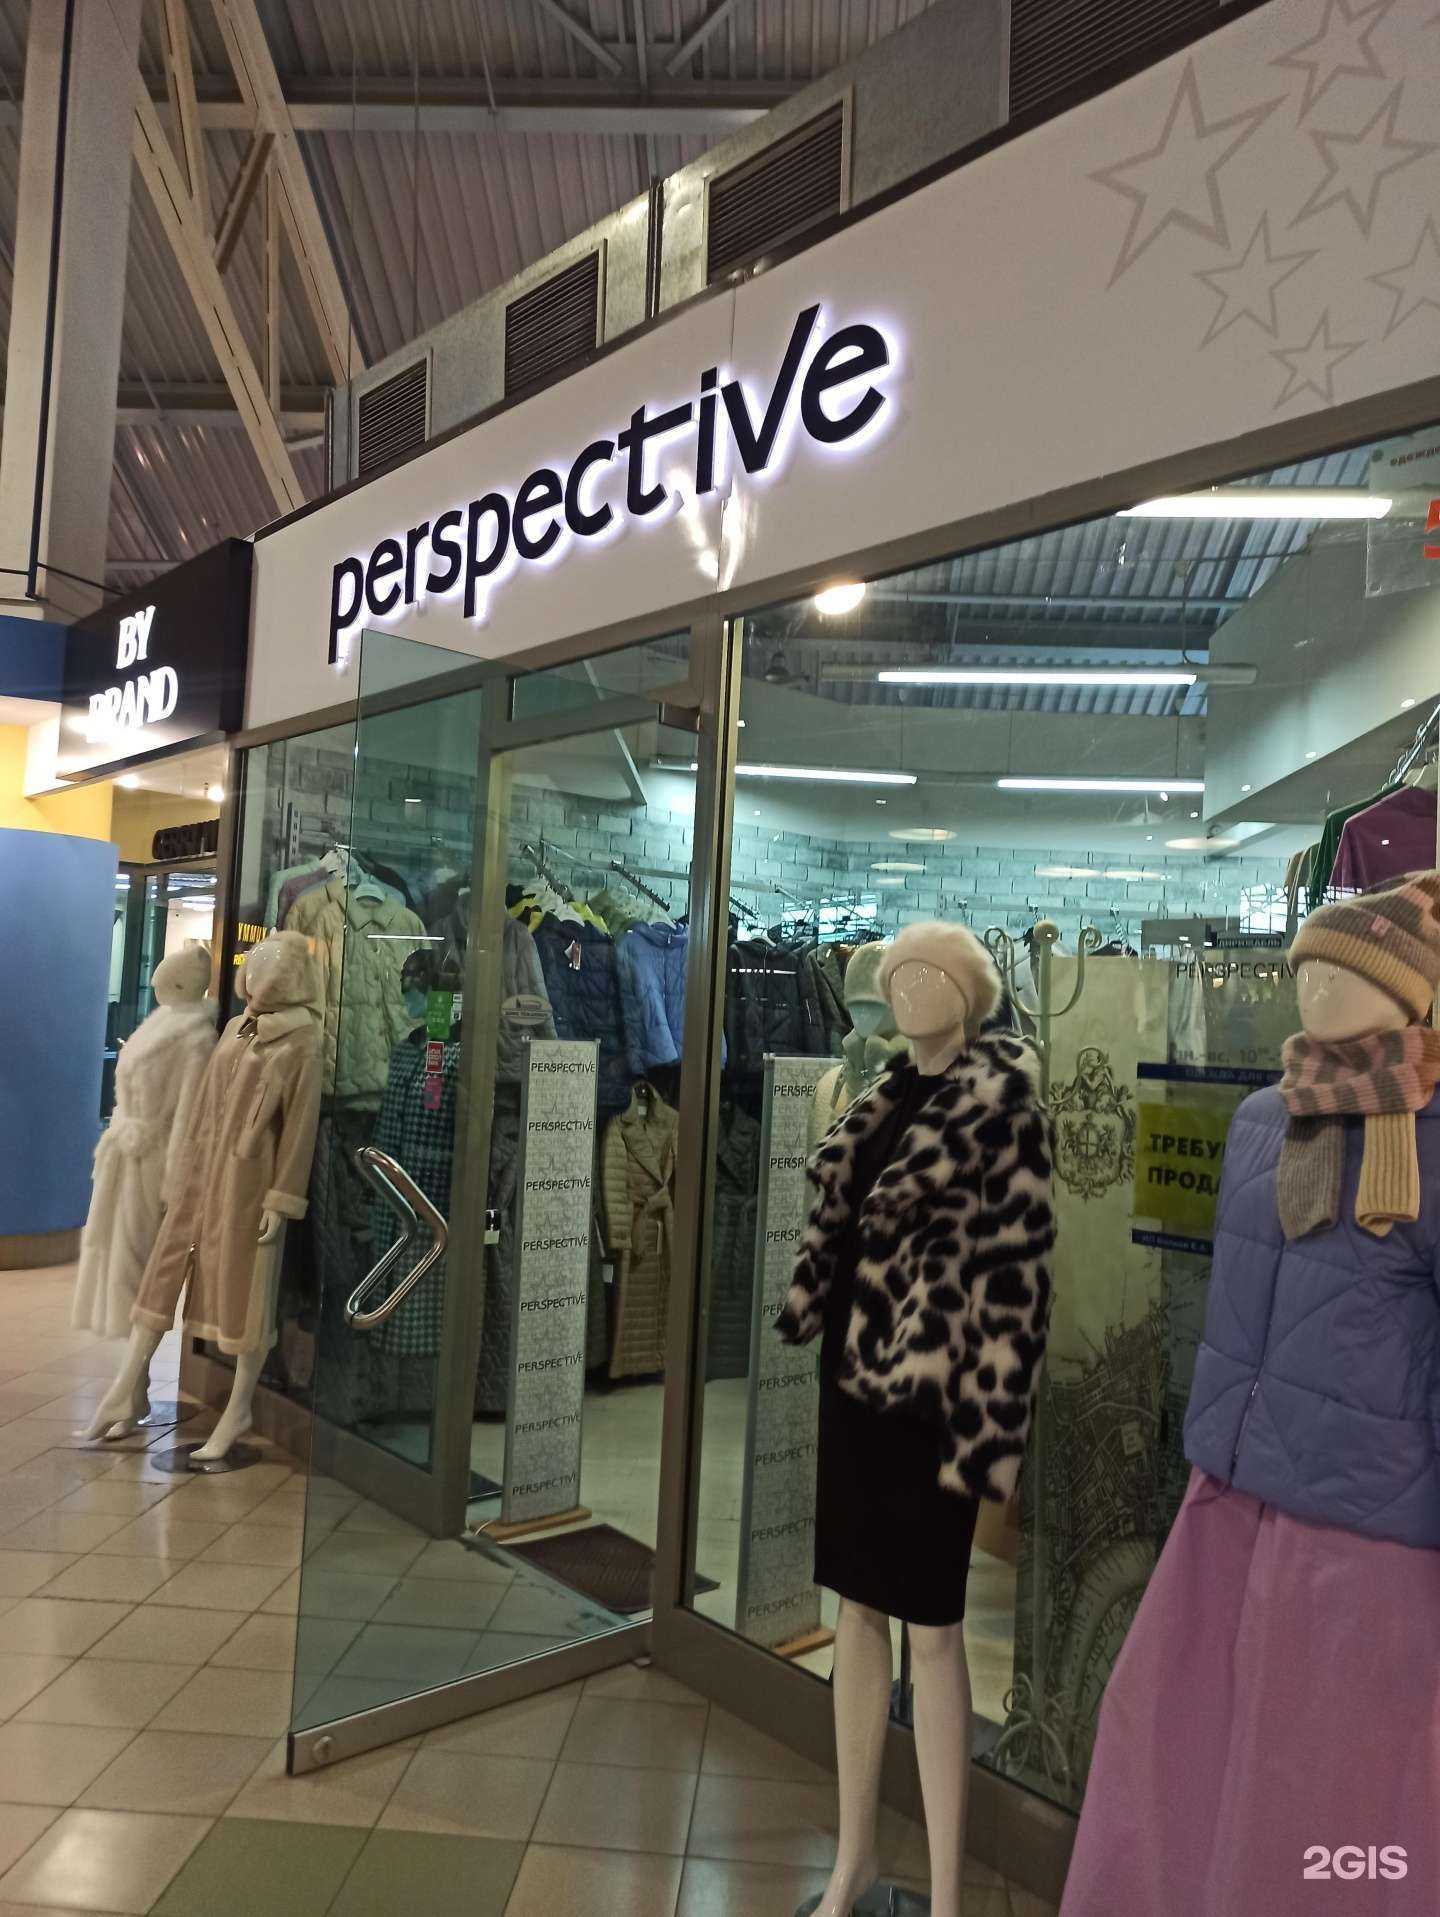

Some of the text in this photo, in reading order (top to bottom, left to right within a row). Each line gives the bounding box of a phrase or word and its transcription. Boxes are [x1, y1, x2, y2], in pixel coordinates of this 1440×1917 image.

[328, 303, 889, 664] perspective
[116, 605, 156, 669] BY
[86, 666, 178, 743] BRAND
[1176, 962, 1298, 979] PERSPECTIV
[531, 1061, 596, 1073] PERSPECTIVE
[529, 1117, 593, 1131] PERSPECTIVE
[526, 1176, 591, 1191] PERSPECTIVE
[523, 1234, 588, 1251] PERSPECTIVE
[766, 1228, 801, 1242] PERSP
[520, 1291, 586, 1312] PERSPECTIVE
[518, 1351, 584, 1373] PERSPECTIVE
